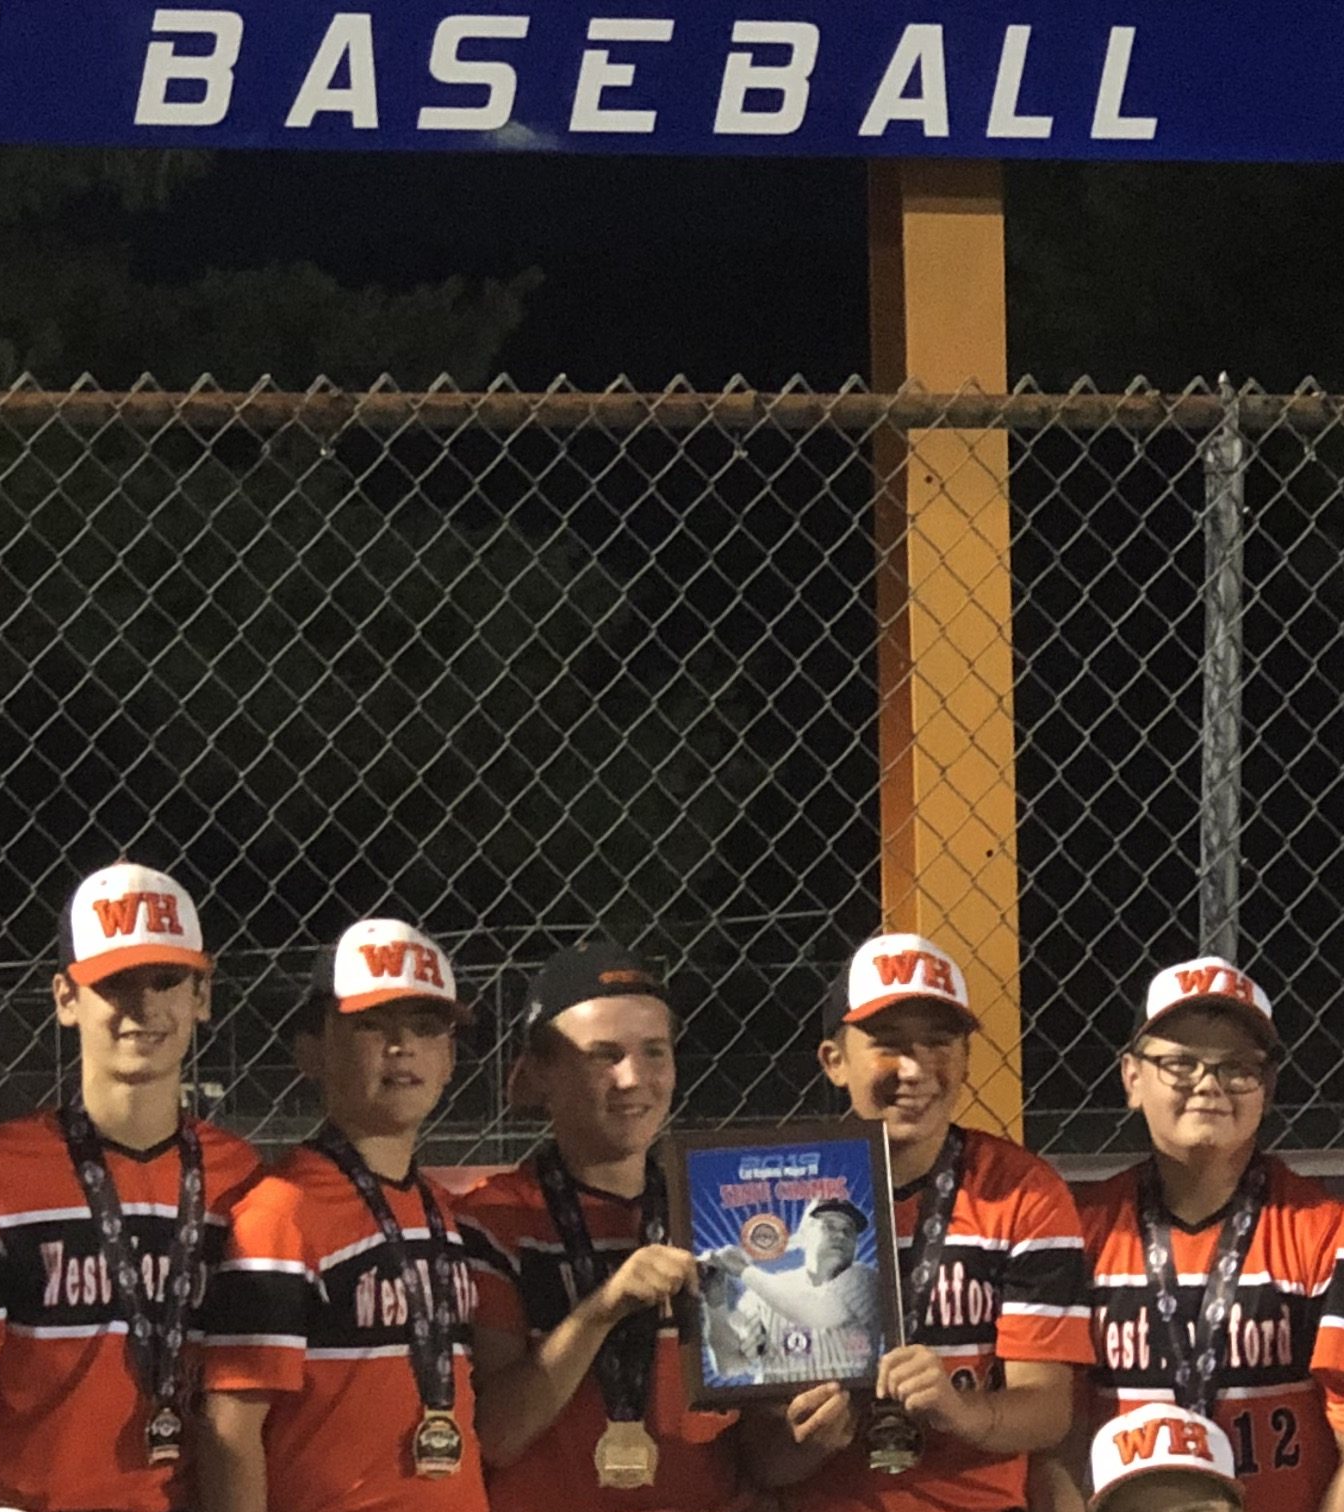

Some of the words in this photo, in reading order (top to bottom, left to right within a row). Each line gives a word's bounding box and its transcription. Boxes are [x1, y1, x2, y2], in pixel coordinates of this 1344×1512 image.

[134, 8, 1161, 141] BASEBALL
[92, 892, 184, 938] WH
[359, 941, 445, 989] WH
[873, 950, 956, 996] WH
[1113, 1417, 1215, 1465] WH
[1232, 1405, 1302, 1478] 12
